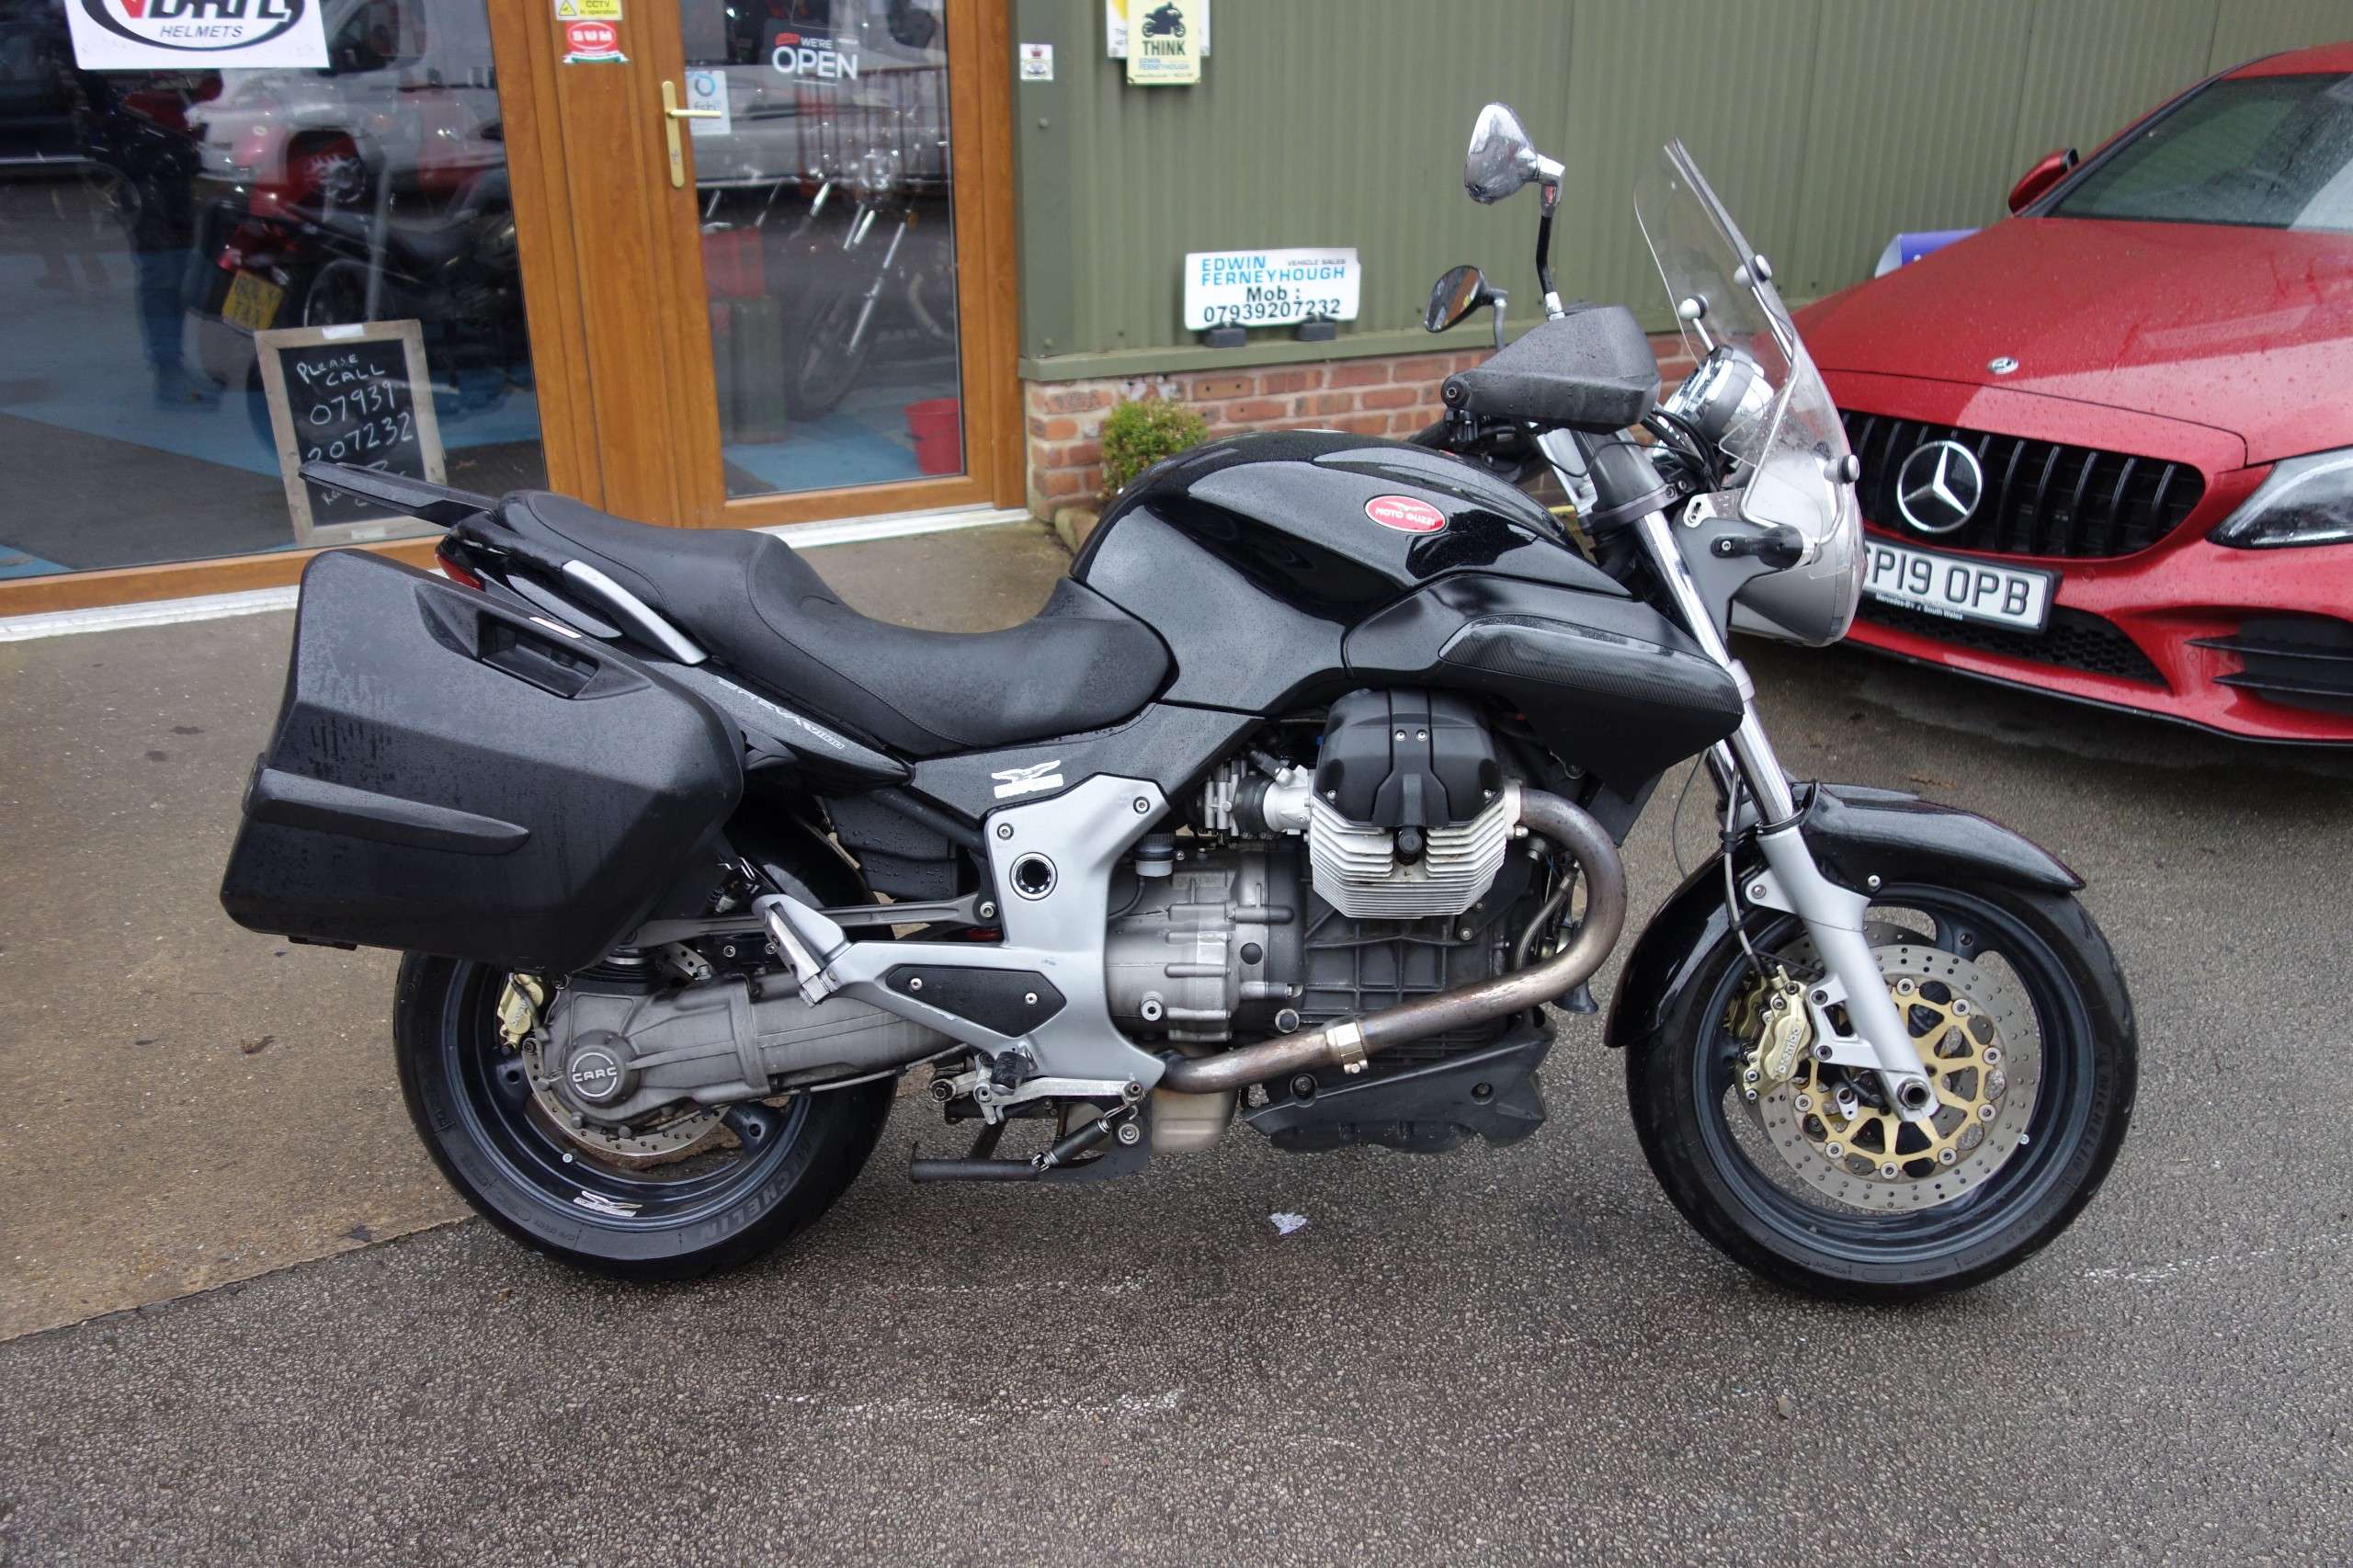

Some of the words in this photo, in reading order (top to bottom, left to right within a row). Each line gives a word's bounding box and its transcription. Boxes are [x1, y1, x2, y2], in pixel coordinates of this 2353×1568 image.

[160, 25, 244, 38] HELMETS
[801, 37, 832, 49] WE'RE
[1142, 40, 1187, 56] THINK
[772, 46, 858, 80] OPEN
[1201, 256, 1267, 272] EDWIN
[1201, 267, 1346, 286] FERNEYHOUGH
[1203, 299, 1341, 323] 07939207232
[325, 364, 385, 386] CALL
[310, 381, 395, 426] 07939
[308, 411, 413, 460] 207232
[1375, 507, 1404, 518] MOTO
[1405, 513, 1436, 526] GUZZI
[1866, 545, 1933, 595] P19
[1944, 564, 2030, 616] OPB
[572, 1066, 618, 1083] CARC
